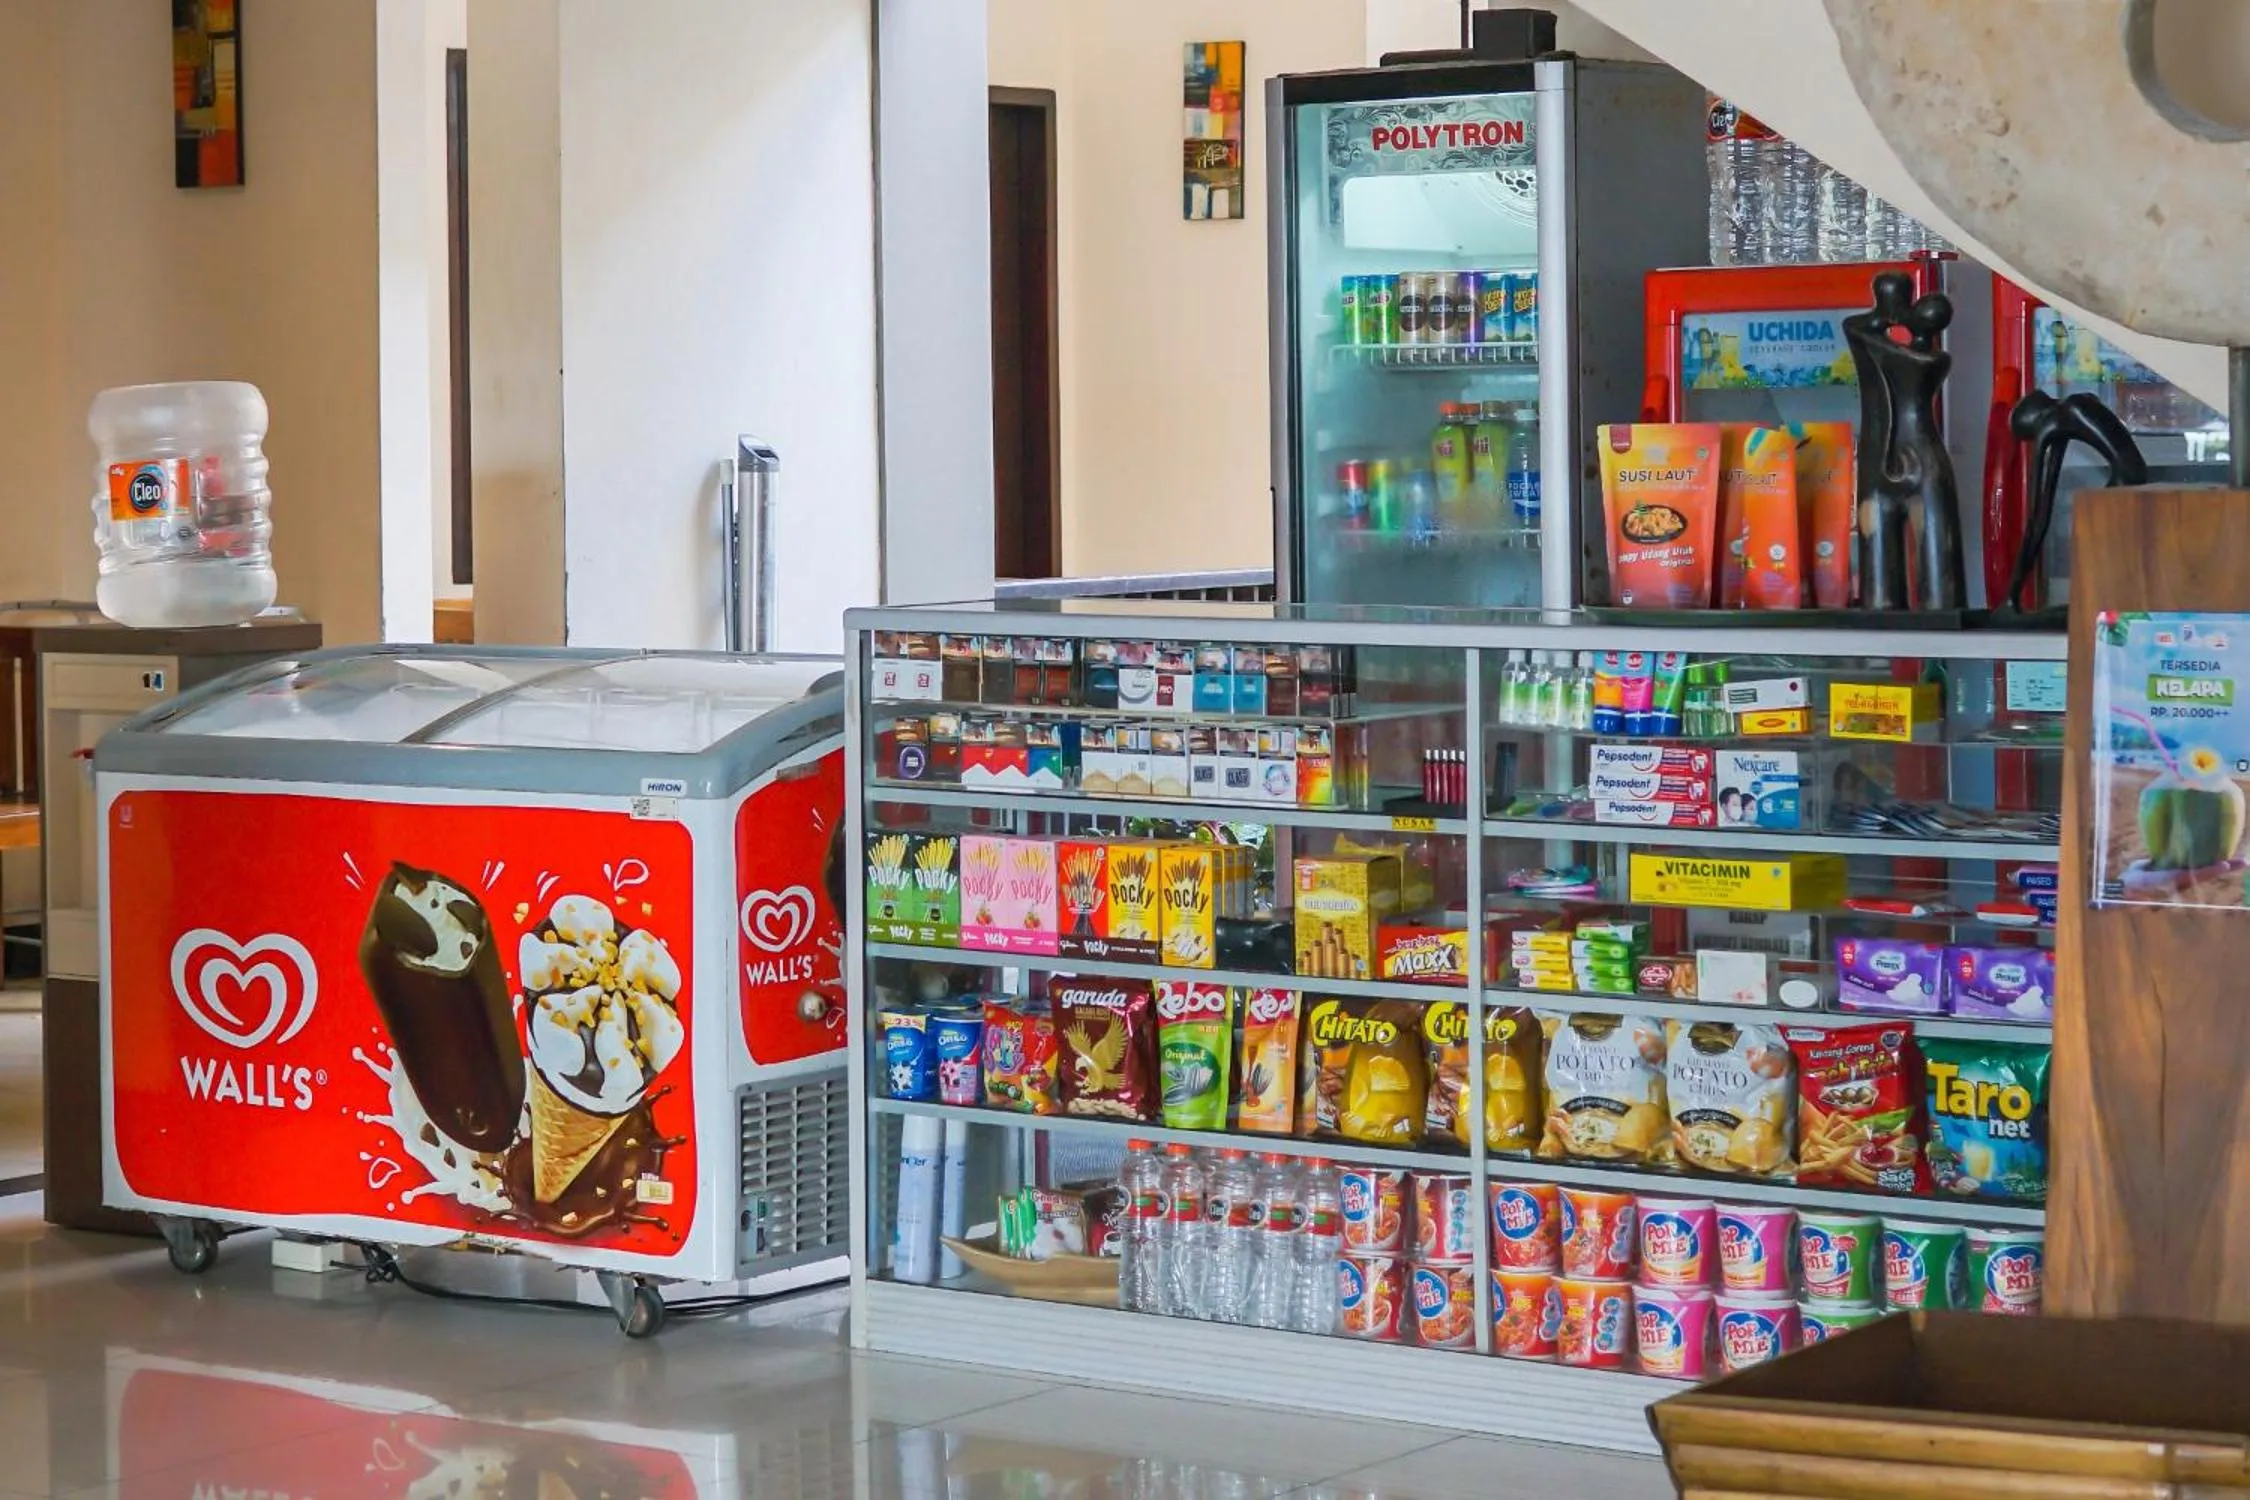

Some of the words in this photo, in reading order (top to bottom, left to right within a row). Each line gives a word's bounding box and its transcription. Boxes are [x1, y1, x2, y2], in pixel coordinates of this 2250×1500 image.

[1372, 121, 1524, 151] POLYTRON
[1748, 320, 1835, 342] UCHIDA
[1619, 471, 1652, 482] SUSI
[1656, 470, 1695, 481] LAUT
[134, 482, 160, 501] Cleo
[2160, 660, 2221, 671] TERSEDIA
[2156, 679, 2226, 697] KELAPA
[1597, 749, 1652, 763] Pepsodent
[1734, 757, 1779, 776] Nexcare
[1595, 775, 1651, 789] Pepsodent
[1609, 801, 1657, 814] Pepsodent
[1664, 860, 1751, 879] VITACIMIN
[746, 954, 813, 987] WALL'S
[1062, 984, 1127, 1008] garuda
[180, 1055, 314, 1112] WALL'S
[1925, 1062, 2032, 1120] Taro
[1988, 1117, 2031, 1138] net
